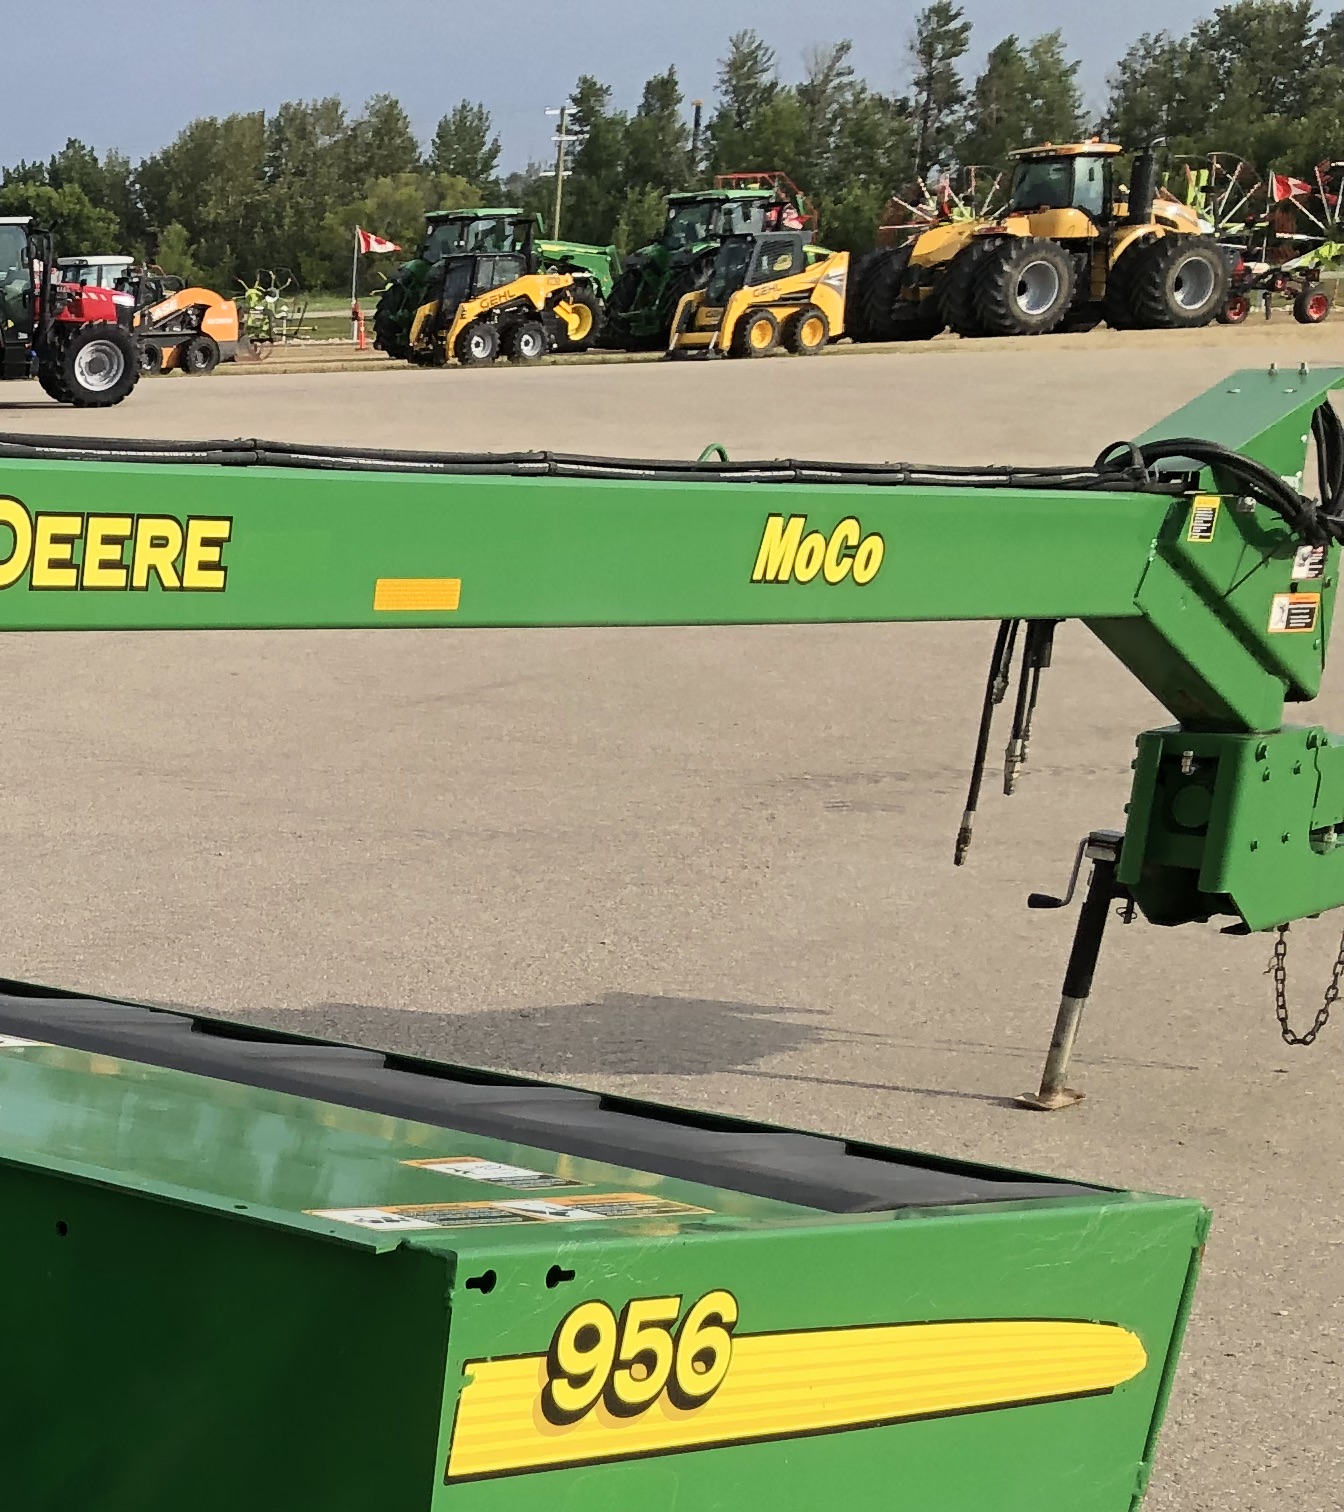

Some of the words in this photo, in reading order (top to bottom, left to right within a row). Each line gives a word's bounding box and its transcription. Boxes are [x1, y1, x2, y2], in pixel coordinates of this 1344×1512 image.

[480, 290, 516, 309] GEHL
[749, 512, 886, 587] MoCo
[540, 1287, 739, 1427] 956
